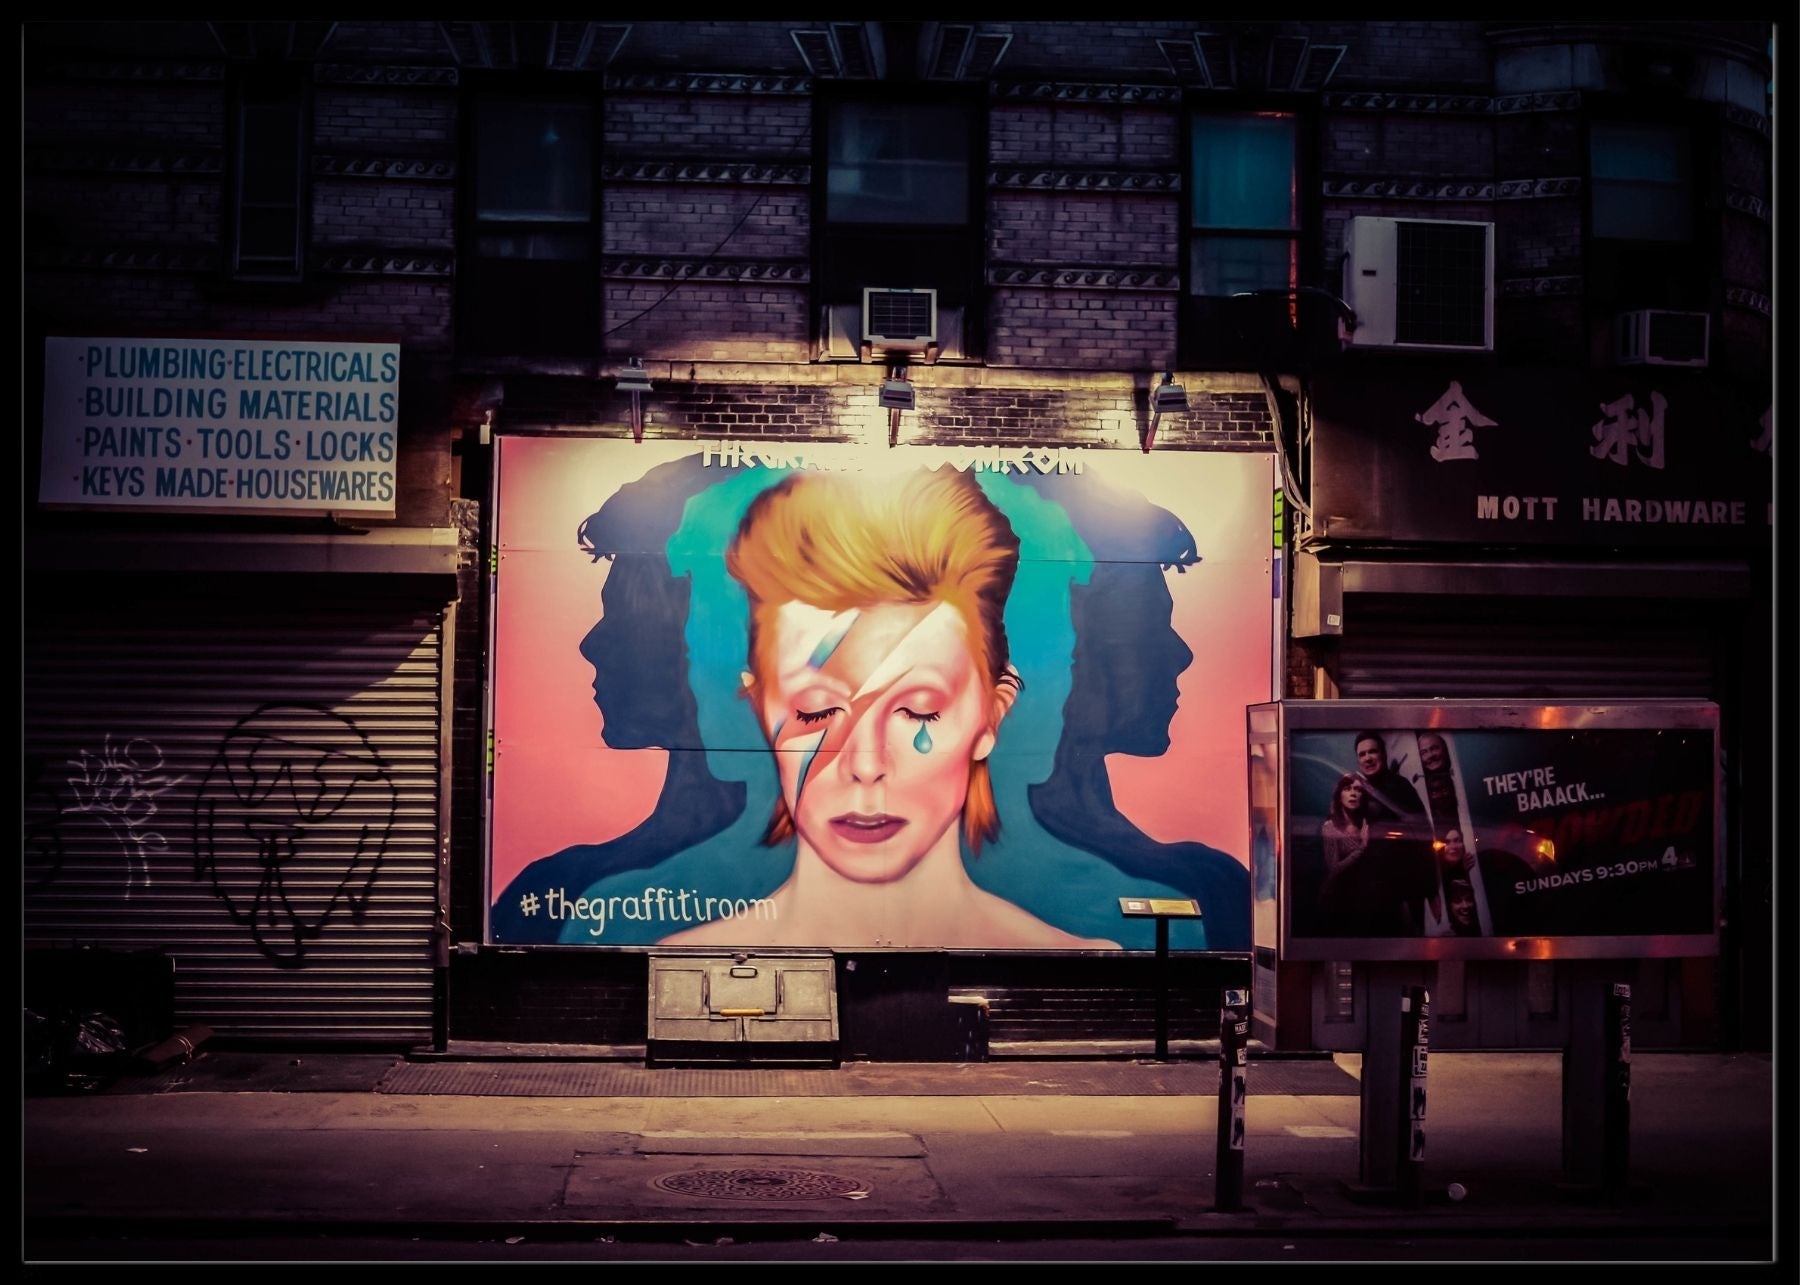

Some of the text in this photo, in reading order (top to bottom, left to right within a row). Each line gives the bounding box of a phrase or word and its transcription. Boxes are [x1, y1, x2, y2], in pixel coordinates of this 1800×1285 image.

[86, 346, 397, 384] PLUMBING ELECTRICALS
[85, 387, 395, 423] BUILDING MATERIALS
[1414, 378, 1771, 471] 金利
[84, 427, 394, 463] PAINTS TOOLS LOCKS
[82, 466, 394, 501] KEYS MADE HOUSEWARES
[1477, 495, 1559, 520] MOTT
[1582, 497, 1746, 525] HARDWARE
[1483, 766, 1556, 796] THEY'RE
[1516, 782, 1606, 813] BAAACK...
[1660, 845, 1679, 866] 4
[1514, 868, 1594, 895] SUNDAYS
[520, 887, 778, 936] #thegraffitiroom
